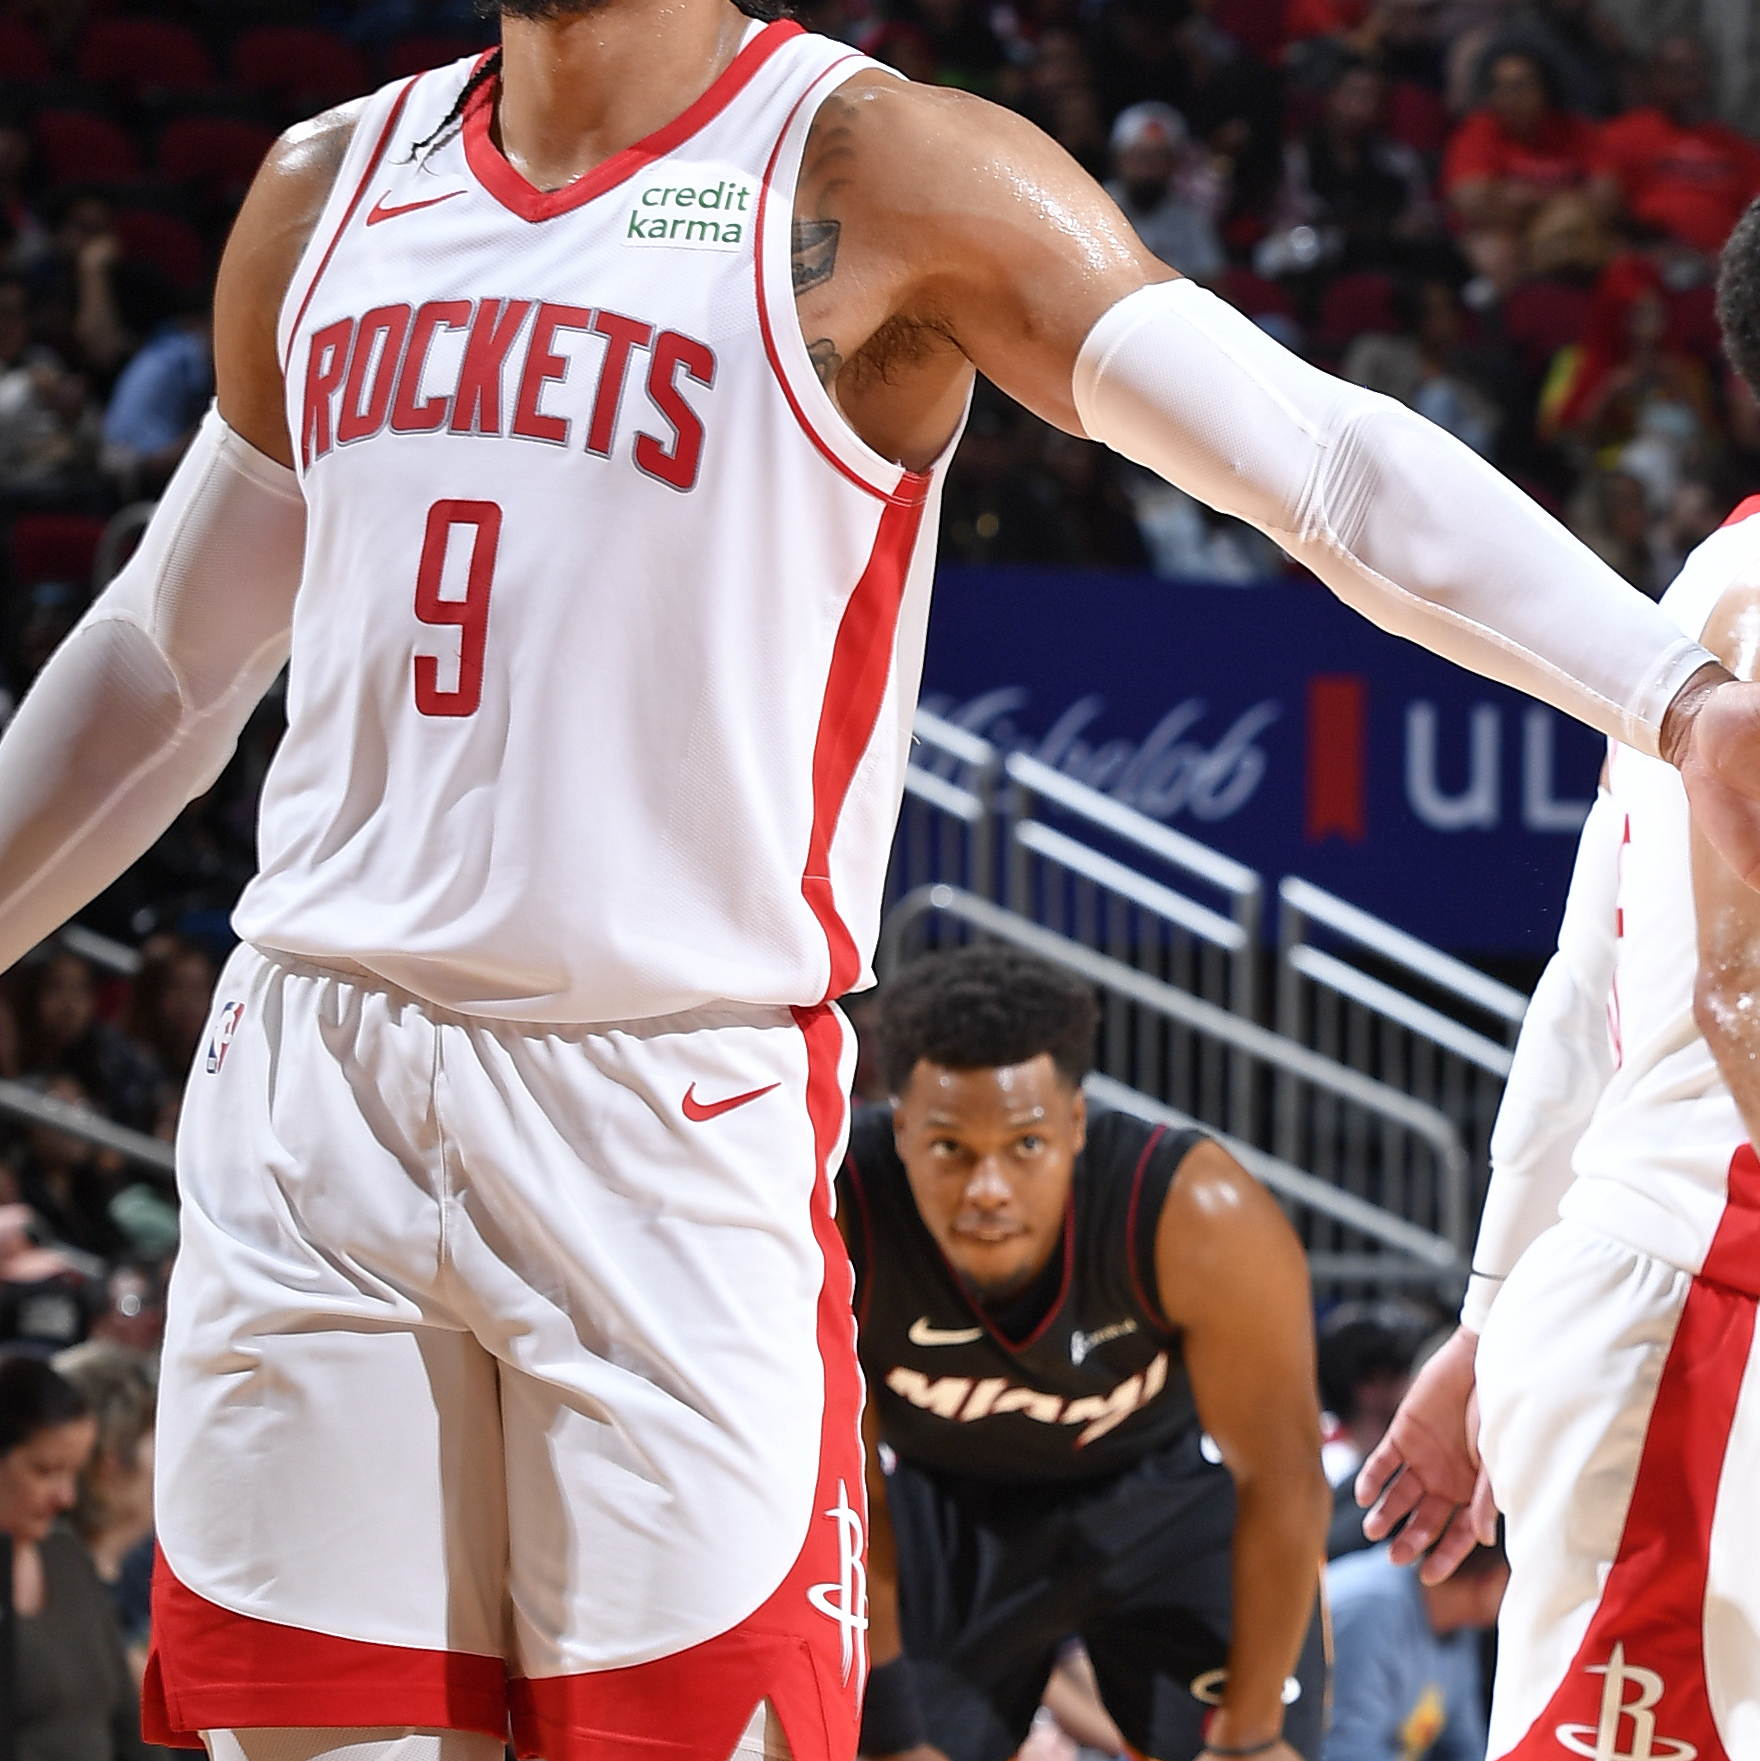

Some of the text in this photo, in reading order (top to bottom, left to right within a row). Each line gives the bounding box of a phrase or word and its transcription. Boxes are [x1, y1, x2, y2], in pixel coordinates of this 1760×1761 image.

[626, 211, 743, 244] karma
[641, 181, 751, 212] credit
[302, 297, 718, 493] ROCKETS
[414, 499, 503, 718] 9
[916, 686, 1281, 822] helob
